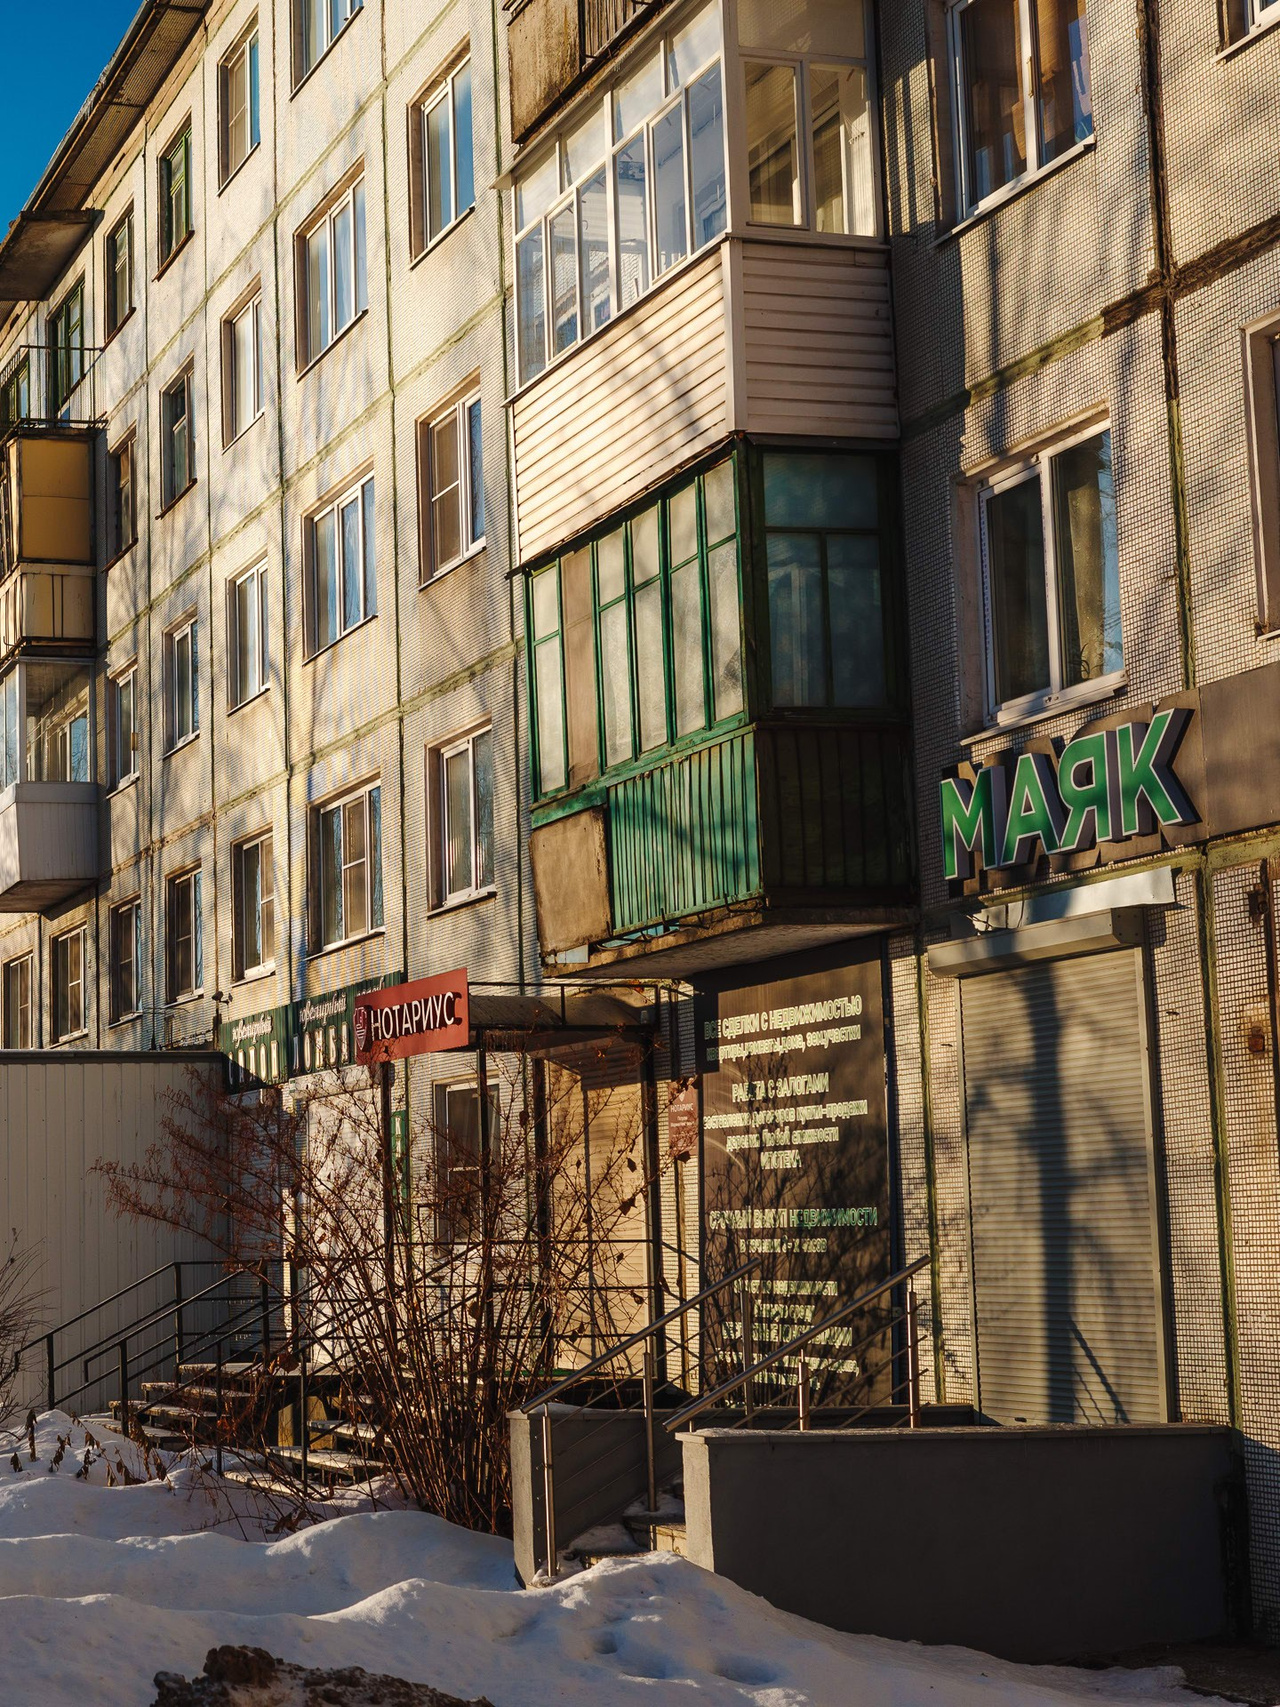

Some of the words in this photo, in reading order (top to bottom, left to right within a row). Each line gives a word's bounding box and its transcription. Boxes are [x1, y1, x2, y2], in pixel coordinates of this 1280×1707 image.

[939, 707, 1192, 881] МАЯК
[299, 992, 347, 1031] ювелирный
[371, 991, 455, 1041] НОТАРИУС
[722, 1012, 760, 1040] СДЕЛКИ
[760, 1011, 769, 1031] С
[769, 994, 863, 1031] НЕДВИЖИМОСТЬЮ
[293, 1021, 357, 1073] ЛОМБА
[776, 1072, 829, 1098] ЗАЛОГАМИ
